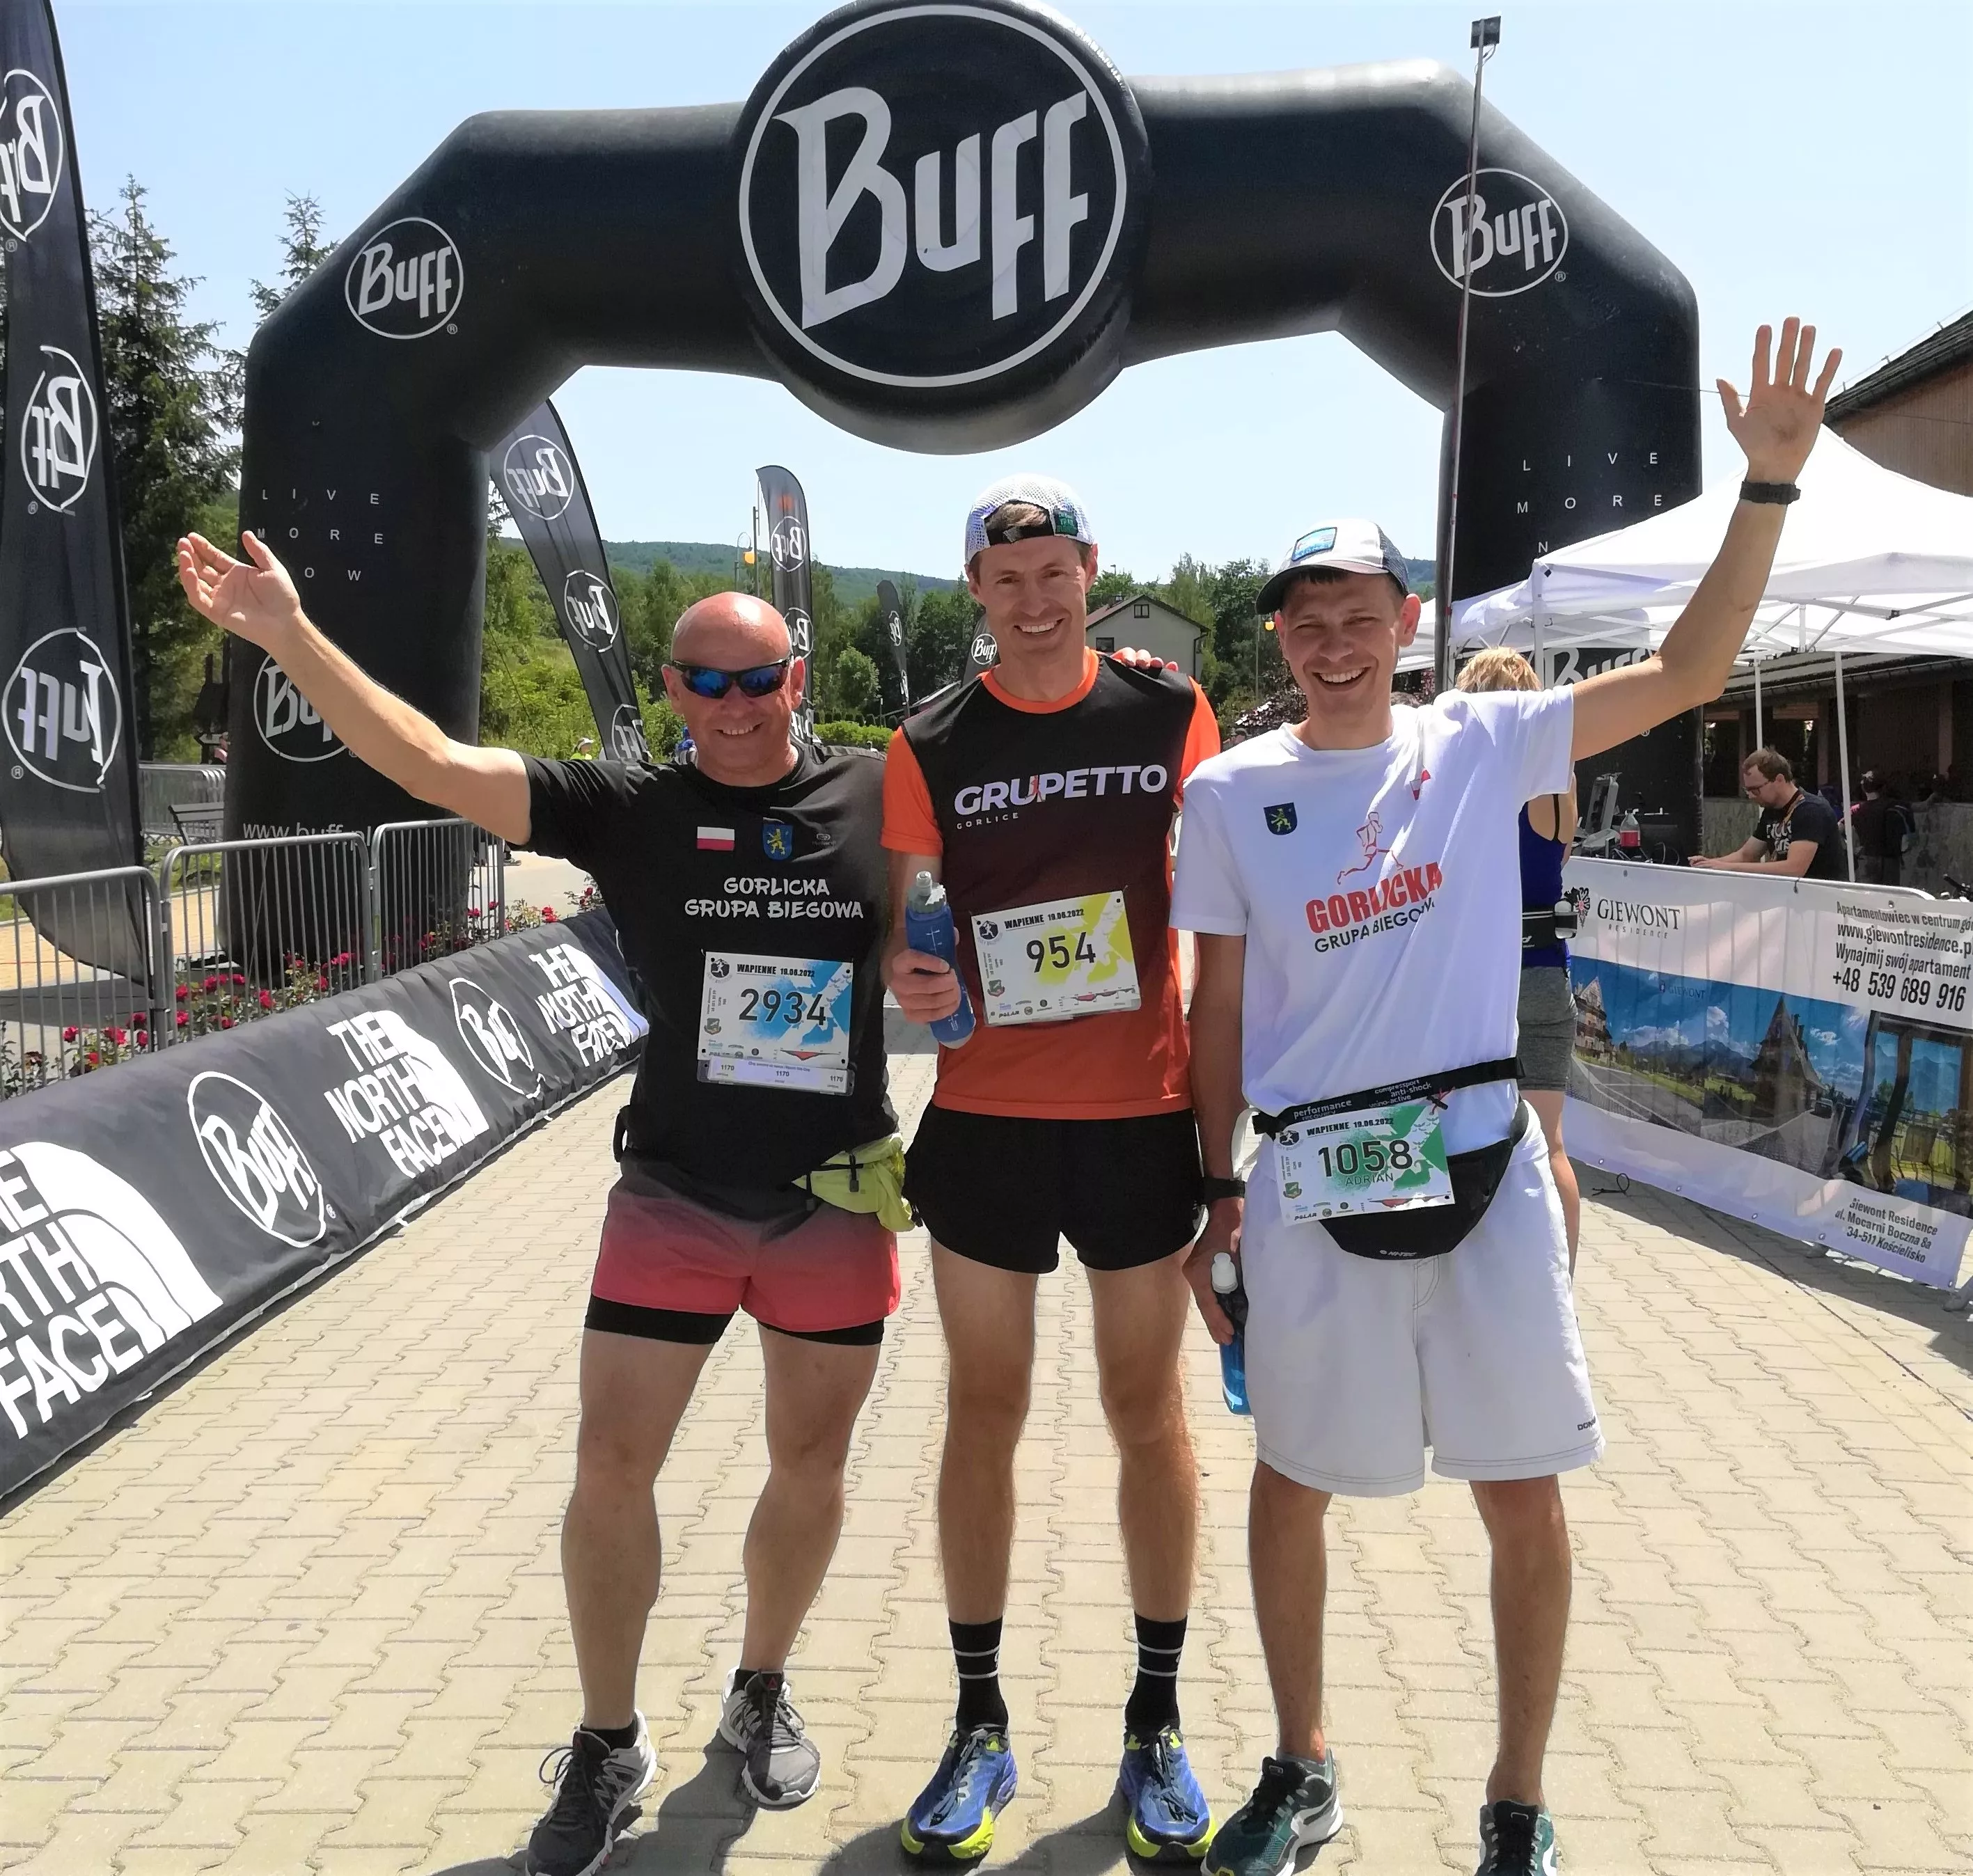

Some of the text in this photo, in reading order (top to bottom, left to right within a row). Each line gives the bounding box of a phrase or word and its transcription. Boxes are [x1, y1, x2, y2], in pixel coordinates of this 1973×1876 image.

[1523, 452, 1658, 471] LIVE
[262, 488, 379, 505] LIVE
[1517, 495, 1662, 514] MORE
[954, 764, 1168, 815] GRUPETTO
[957, 812, 1019, 829] GORLICE
[723, 877, 830, 896] GORLICKA
[1306, 862, 1443, 933] GORLICKA
[684, 899, 864, 919] GRUPA BIEGOWA
[1005, 914, 1044, 929] WAPIENNE
[1597, 899, 1681, 930] GIEWONT
[1837, 901, 1910, 924] Apartamentowiec
[1911, 913, 1919, 924] w
[1921, 913, 1960, 930] centrum
[1315, 897, 1435, 953] GRUPA BIEGOW
[1608, 924, 1668, 939] RESIDENCE
[528, 945, 582, 988] THE
[1026, 931, 1096, 973] 954
[1836, 942, 1972, 980] Wynajmij swój apartament
[737, 963, 776, 975] WAPIENNE
[1833, 967, 1967, 1012] +48 539 689 916
[739, 988, 826, 1026] 2934
[326, 1011, 400, 1073] THE
[324, 1055, 429, 1144] NORTH
[1390, 1082, 1432, 1098] anti-shock
[1294, 1099, 1352, 1120] performance
[379, 1105, 457, 1179] FACE
[1307, 1121, 1350, 1136] WAPIENNE
[1318, 1139, 1413, 1178] 1058
[1345, 1173, 1394, 1187] ADRIAN
[1848, 1211, 1885, 1234] Mocarni
[1887, 1224, 1920, 1245] Boczna
[1920, 1236, 1932, 1250] 8a
[1888, 1210, 1938, 1236] Residence
[1846, 1226, 1926, 1263] 34-511 Kościelisko
[0, 1292, 144, 1439] FACE
